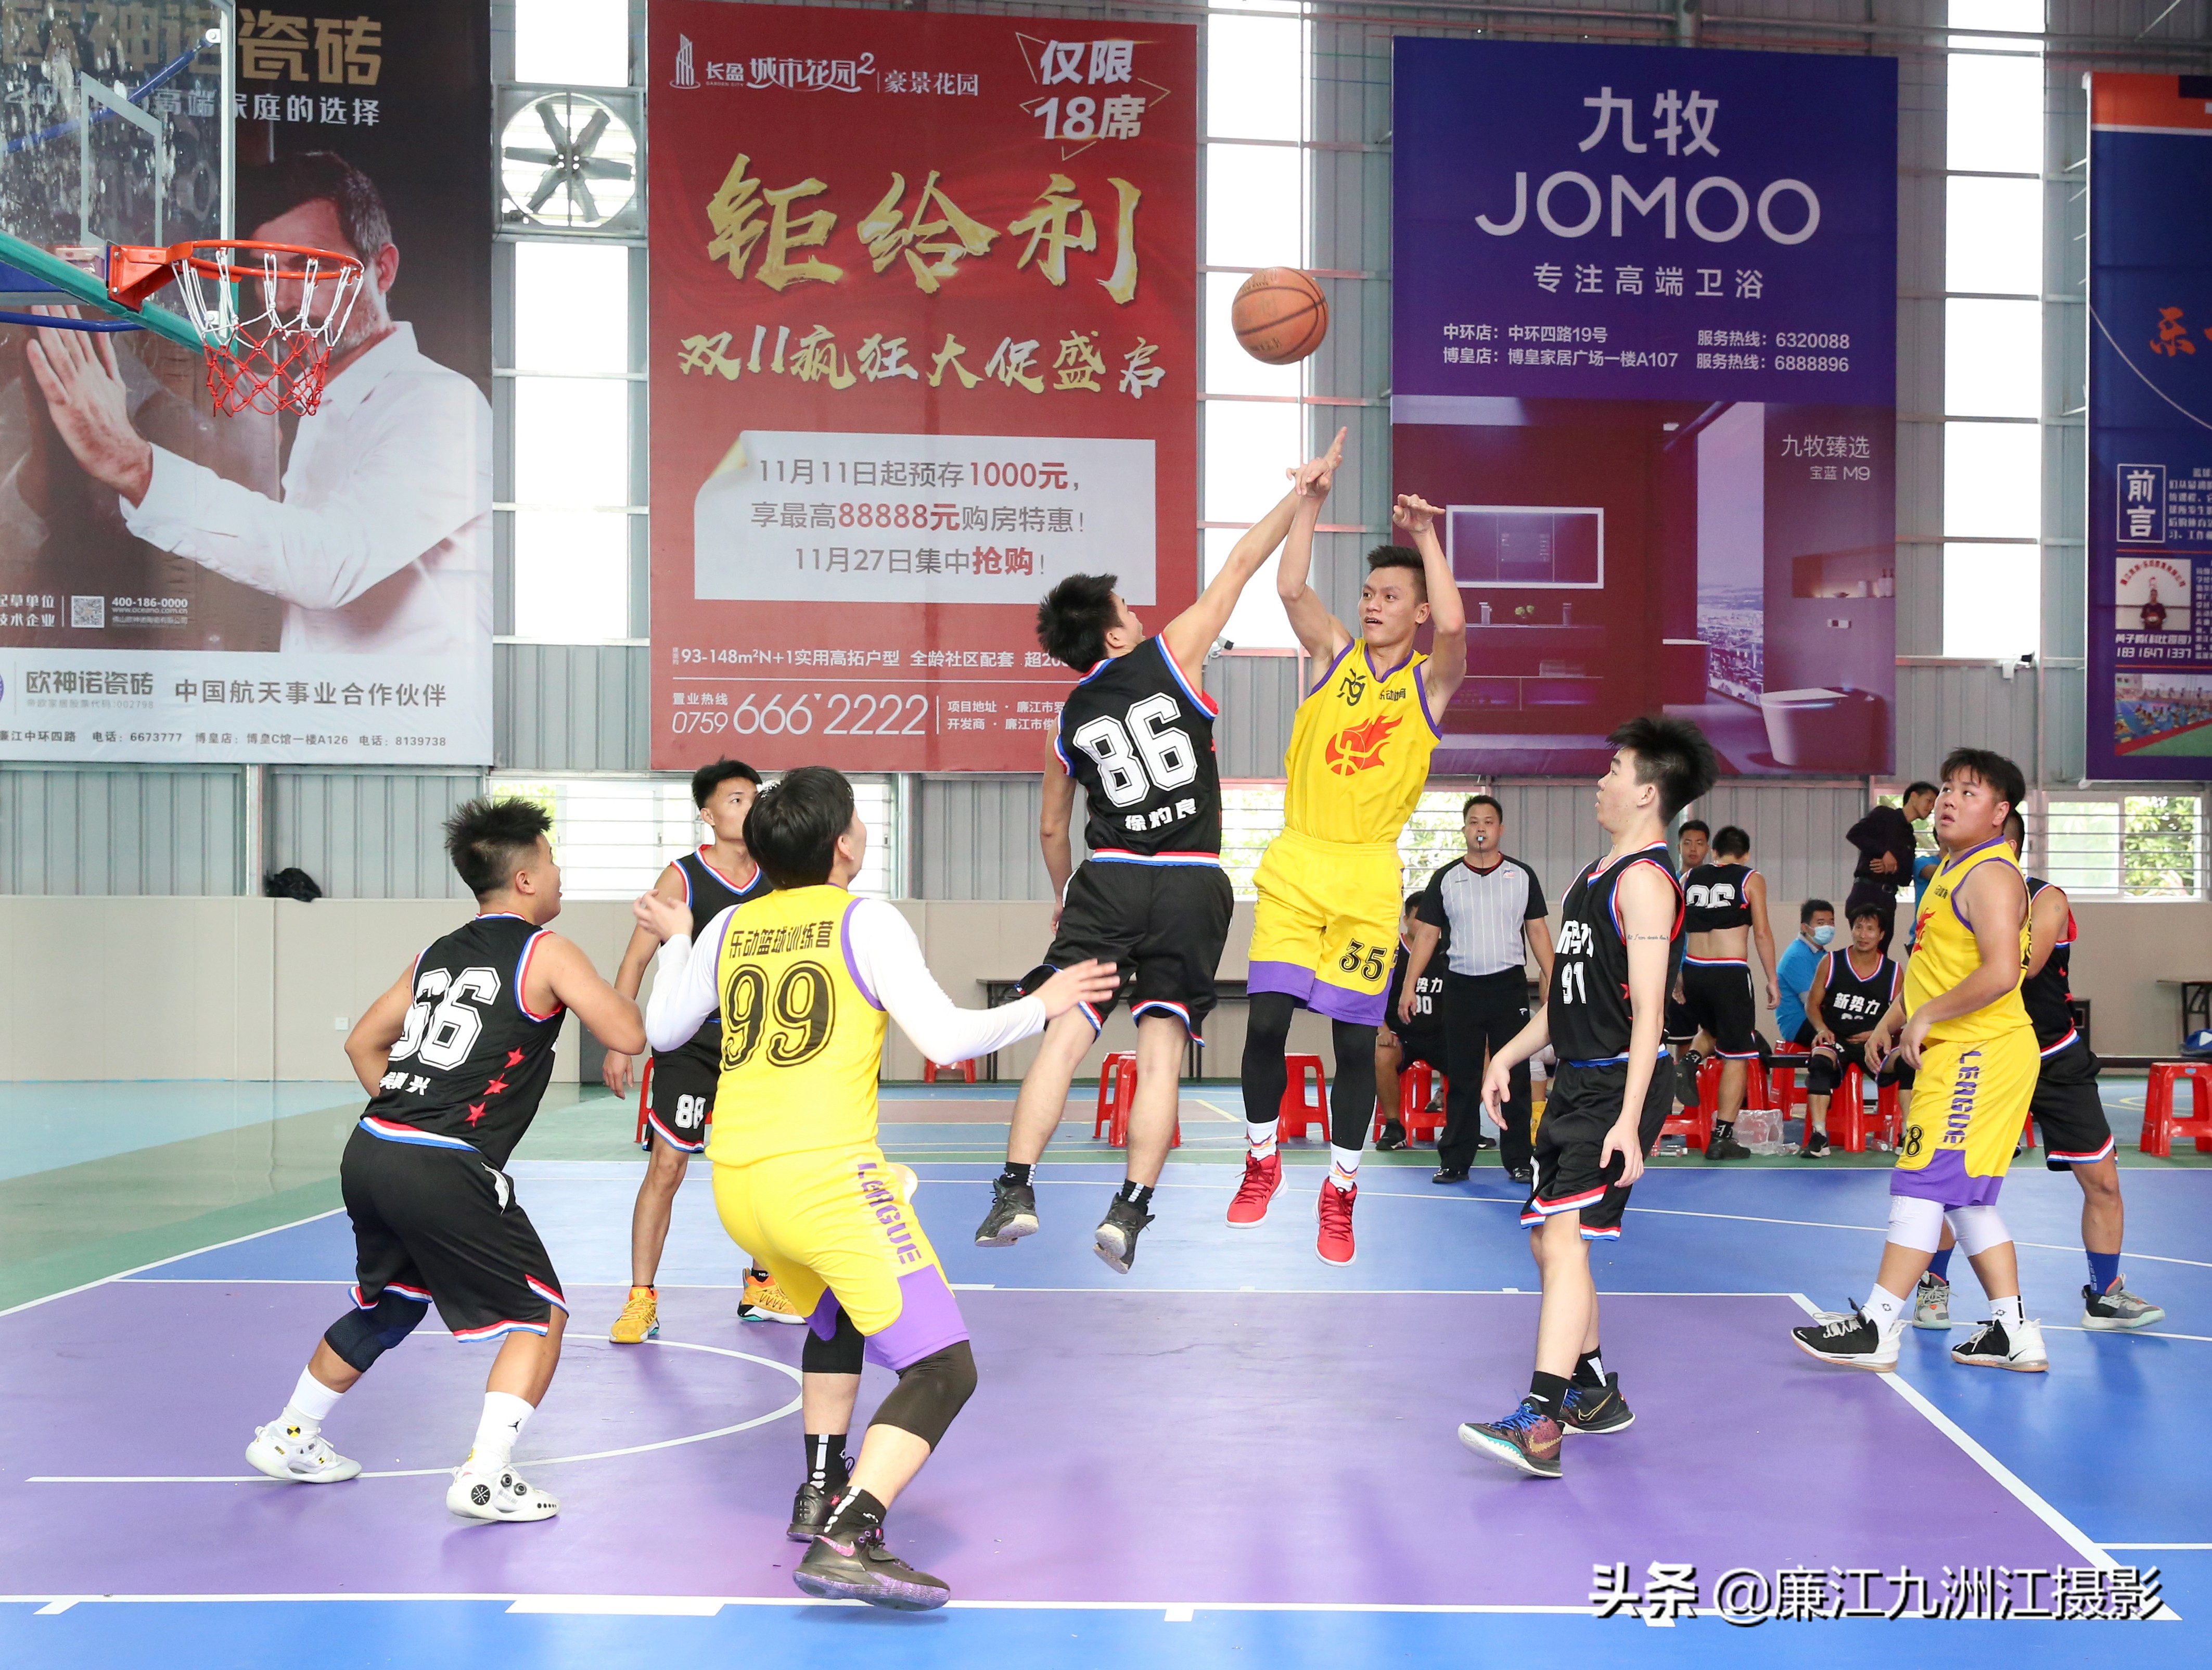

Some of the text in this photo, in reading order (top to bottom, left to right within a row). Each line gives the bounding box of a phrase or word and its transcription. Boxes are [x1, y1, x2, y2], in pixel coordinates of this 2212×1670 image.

[706, 61, 744, 81] 长盈
[885, 70, 979, 96] 豪景花园
[1040, 40, 1134, 85] 仅限
[1034, 94, 1146, 140] 18席
[1578, 87, 1720, 158] 九牧
[1475, 171, 1821, 245] JOMOO
[707, 152, 1142, 304] 钜给利
[1534, 263, 1763, 299] 专注高端卫浴
[677, 324, 1166, 399] 双11疯狂大促盛启
[1781, 435, 1870, 459] 九牧臻选
[1810, 466, 1870, 481] 宝蓝 M9
[2127, 469, 2156, 538] 前言
[112, 597, 188, 608] 400-186-0000
[910, 651, 1014, 668] 全龄社区配套
[26, 670, 153, 695] 欧神诺瓷砖
[175, 679, 446, 707] 中国航天事业合作伙伴
[673, 693, 728, 705] 置业热线
[672, 711, 728, 733] 0759
[948, 701, 997, 713] 项目地址
[948, 718, 985, 730] 开发商
[1072, 692, 1198, 808] 86
[729, 921, 834, 959] 乐动篮球训练营
[1339, 938, 1387, 981] 35
[1561, 962, 1587, 1004] 91
[721, 960, 835, 1071] 99
[1833, 992, 1881, 1015] 新势力
